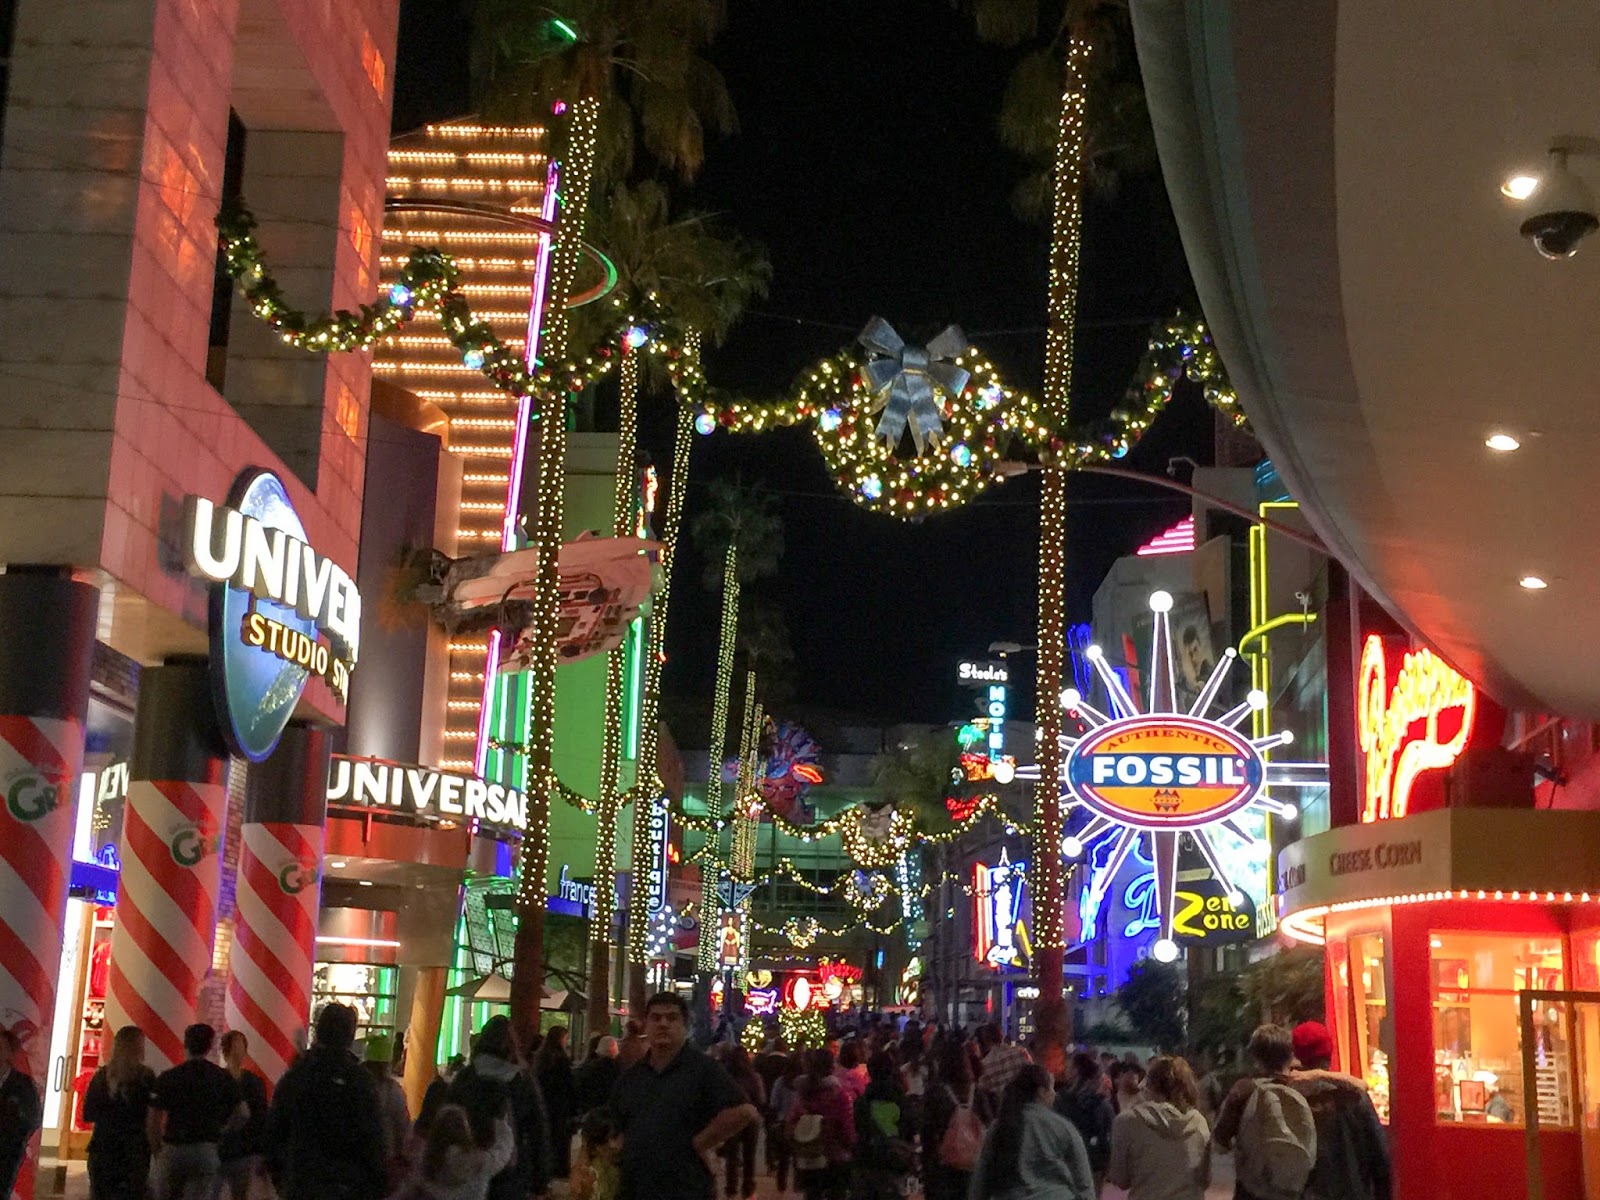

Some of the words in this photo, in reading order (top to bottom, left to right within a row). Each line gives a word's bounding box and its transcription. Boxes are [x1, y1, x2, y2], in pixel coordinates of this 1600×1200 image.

[249, 613, 328, 675] STUDIO
[988, 685, 1006, 764] MOTEL
[1107, 729, 1226, 752] AUTHENTIC
[1093, 756, 1245, 784] FOSSIL
[649, 800, 663, 907] boutique
[1374, 839, 1422, 870] CORN
